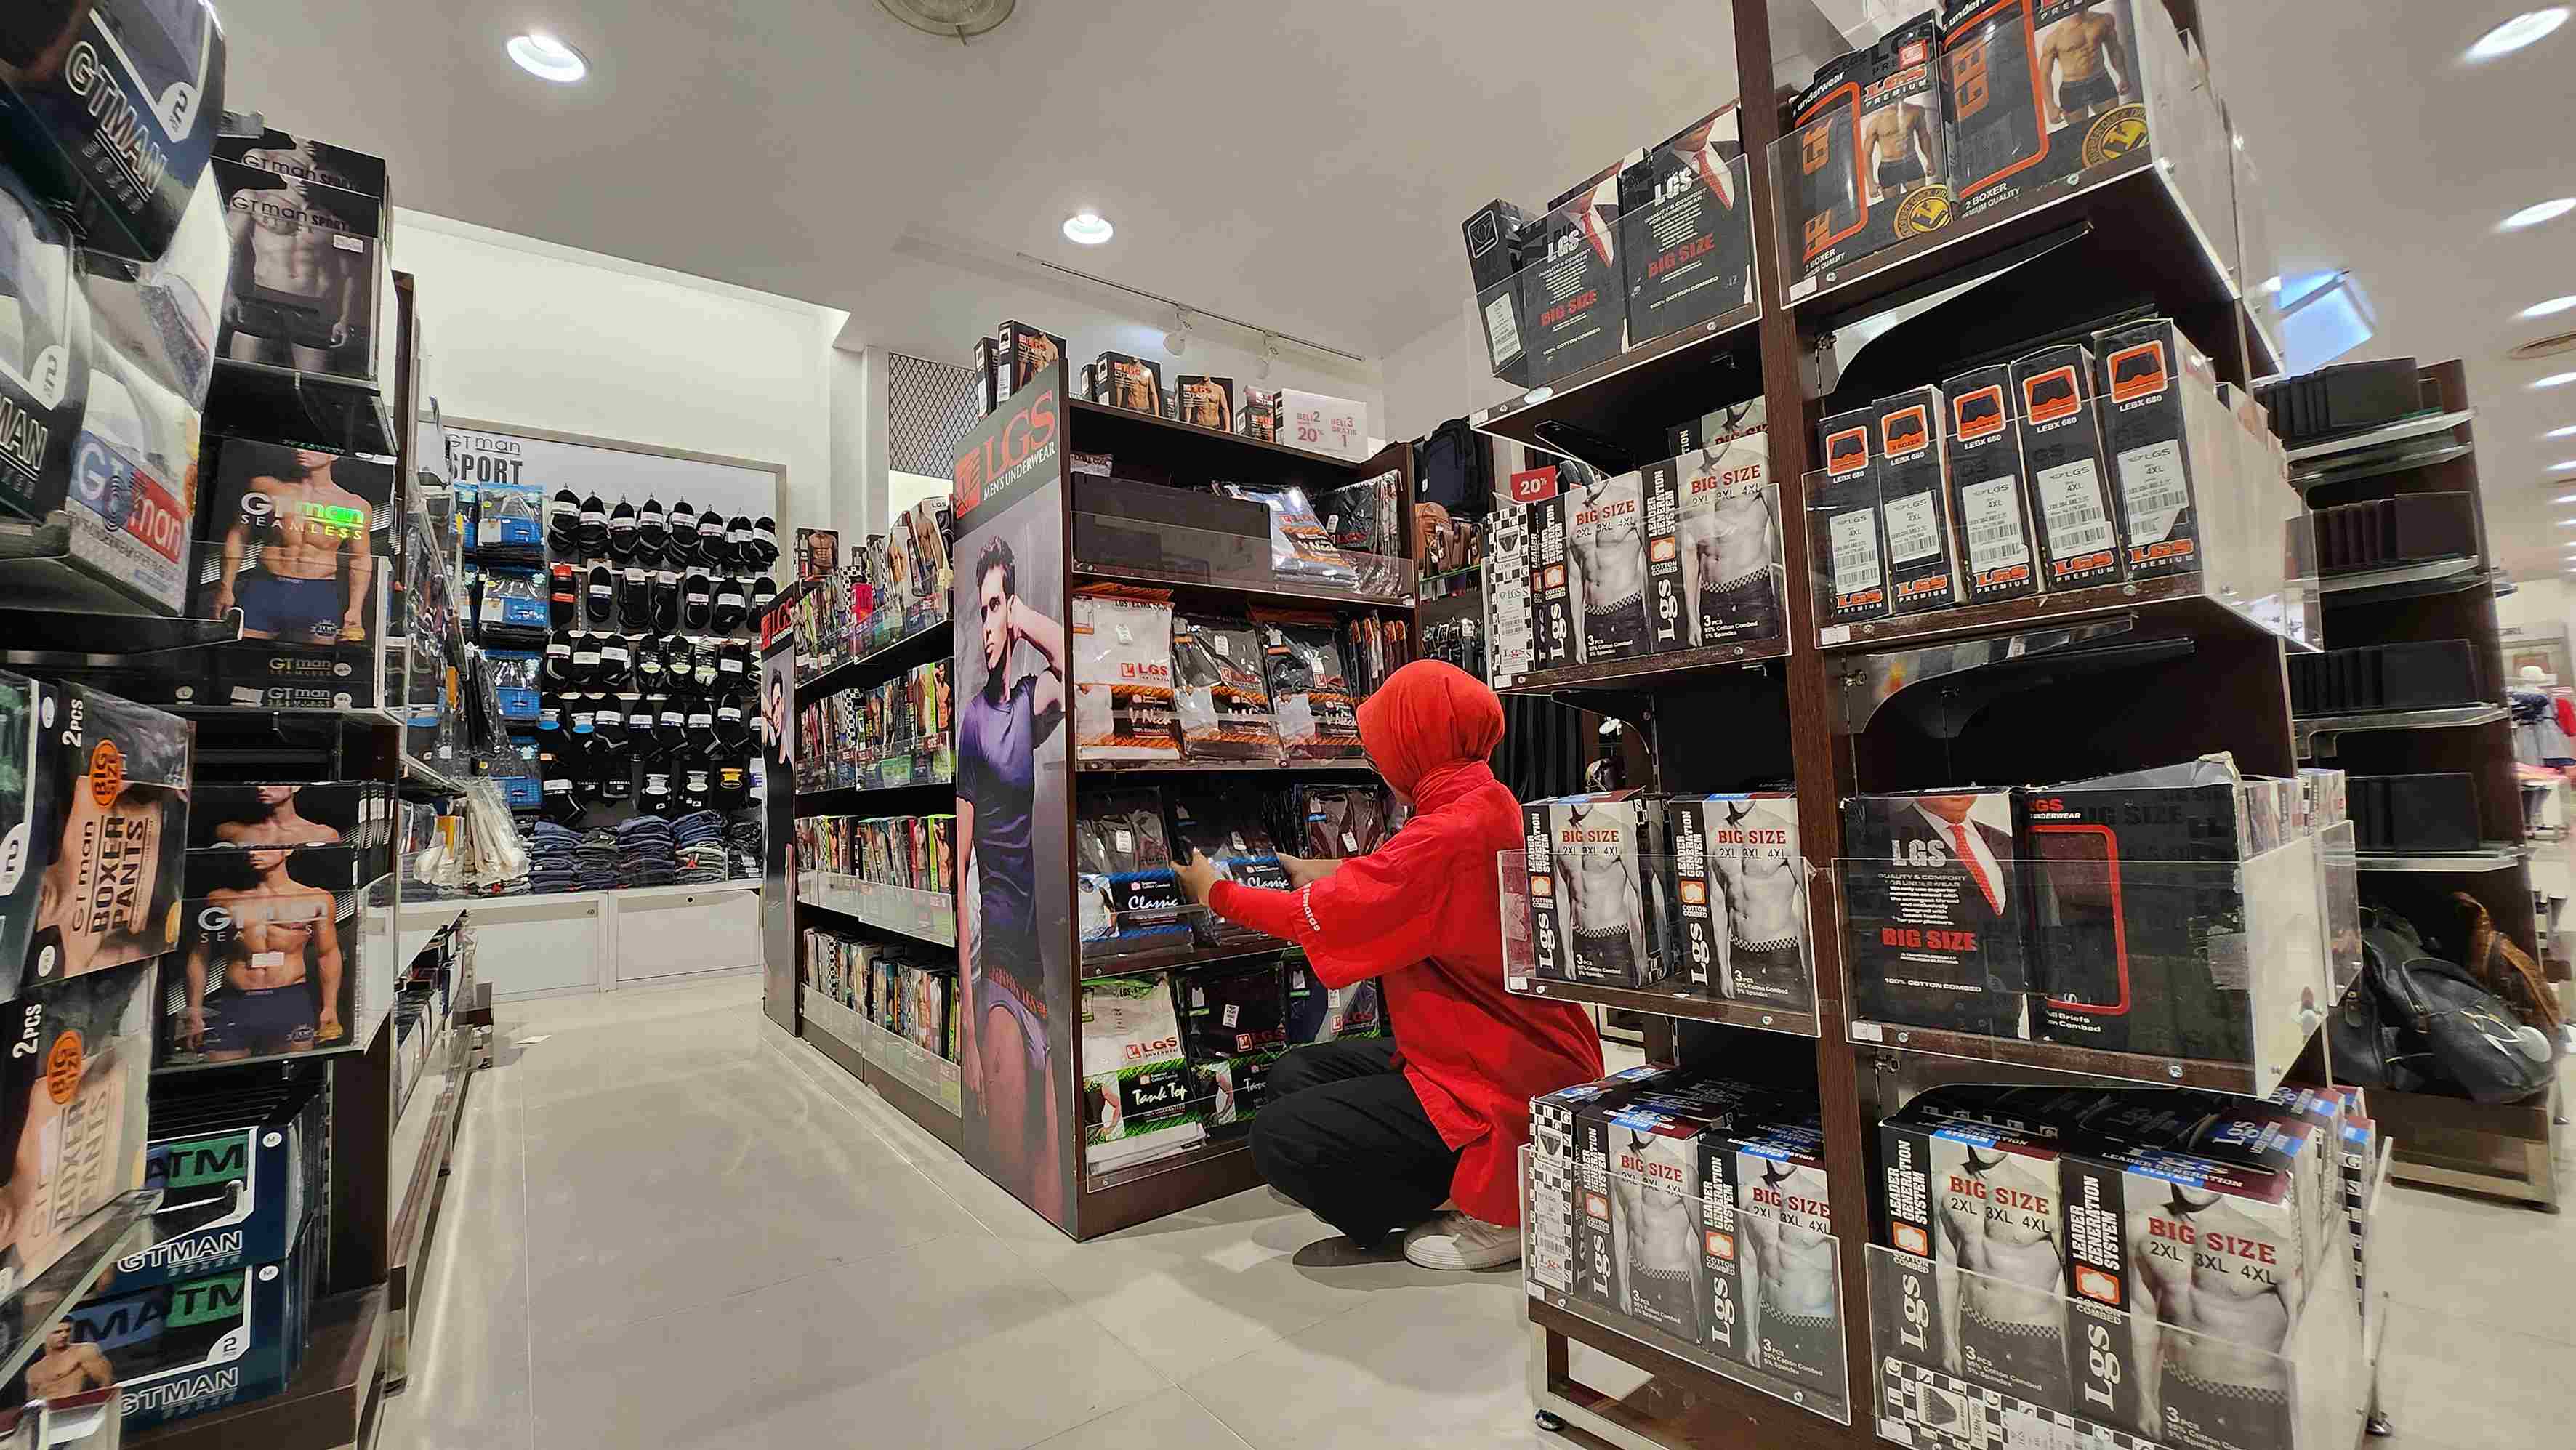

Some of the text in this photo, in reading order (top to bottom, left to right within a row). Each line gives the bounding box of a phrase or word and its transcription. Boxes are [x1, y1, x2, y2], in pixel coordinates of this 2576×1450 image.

[1797, 71, 1844, 110] underwear
[1866, 78, 1926, 108] PREMIUM
[65, 41, 168, 194] GTMAN
[174, 89, 188, 125] 2
[1654, 167, 1692, 206] LGS
[1965, 182, 2008, 210] 2 BOXER
[1988, 187, 2021, 206] QUALITY
[1548, 230, 1579, 263] LGS
[1648, 233, 1715, 279] BIG SIZE
[1810, 249, 1835, 268] BOXER
[1821, 252, 1845, 269] QUALITY
[1666, 276, 1718, 302] COTTON COMBED
[1541, 290, 1597, 326] BIG SIZE
[1557, 337, 1577, 349] COTTON
[45, 353, 58, 380] 2
[2120, 395, 2162, 412] LEBX 680
[1313, 411, 1320, 422] 2
[1347, 417, 1353, 427] 3
[2037, 416, 2077, 433] LEBX 680
[983, 389, 1055, 482] LGS
[1342, 435, 1347, 447] 1
[1964, 439, 1986, 450] LEBX
[1005, 441, 1056, 486] UNDERWEAR
[2144, 448, 2170, 459] LGS
[1691, 464, 1760, 494] BIG SIZE
[1832, 474, 1851, 483] LEBX
[2064, 466, 2090, 478] LGS
[2146, 465, 2165, 475] 4XL
[1520, 477, 1547, 496] 20%
[1741, 483, 1761, 495] 4XL
[1987, 484, 2010, 495] LGS
[2066, 482, 2084, 491] 4XL
[1575, 499, 1635, 526] BIG SIZE
[1654, 470, 1666, 536] GENERATION
[1665, 490, 1675, 533] SYSTEM
[1616, 517, 1635, 528] 4XL
[1647, 496, 1656, 537] LEADER
[2052, 551, 2114, 577] LGS
[2128, 538, 2194, 564] LGS
[2131, 555, 2194, 571] PREMIUM
[1651, 560, 1678, 571] COTTON
[2056, 566, 2114, 582] PREMIUM
[1899, 589, 1947, 603] PREMIUM
[1976, 579, 2030, 594] PREMIUM
[1838, 603, 1882, 614] PREMIUM
[1138, 662, 1168, 676] LGS
[1533, 813, 1542, 872] GENERATION
[1562, 831, 1619, 842] BIG SIZE
[1683, 810, 1695, 877] GENERATION
[1718, 830, 1787, 844] BIG SIZE
[1, 839, 19, 872] 2
[1541, 834, 1550, 872] SYSTEM
[1676, 835, 1686, 876] LEADER
[1694, 834, 1704, 877] SYSTEM
[1891, 839, 1947, 868] LGS
[91, 815, 126, 934] BOXER
[112, 818, 145, 930] PANTS
[1247, 876, 1289, 889] Classic
[1128, 895, 1179, 910] Classic
[1881, 927, 1978, 951] BIG SIZE
[1576, 954, 1582, 965] 3
[1734, 970, 1742, 981] 3
[1907, 980, 1942, 988] COTTON
[1943, 983, 1982, 992] COMBED
[2058, 1012, 2091, 1024] Briefs
[2058, 1023, 2101, 1033] Combed
[1140, 1036, 1178, 1053] LGS
[1132, 1082, 1188, 1105] Tank Top
[1582, 1149, 1592, 1191] LEADER
[1588, 1127, 1598, 1193] GENERATION
[1621, 1154, 1683, 1183] BIG SIZE
[1598, 1151, 1608, 1196] SYSTEM
[1898, 1139, 1913, 1222] GENERATION
[1704, 1180, 1714, 1228] LEADER
[1712, 1156, 1723, 1229] GENERATION
[1752, 1186, 1831, 1219] BIG SIZE
[1887, 1167, 1901, 1217] LEADER
[1912, 1170, 1928, 1225] SYSTEM
[1949, 1175, 2050, 1215] BIG SIZE
[1723, 1184, 1734, 1233] SYSTEM
[1950, 1197, 2050, 1233] 2XL 3XL 4XL
[2083, 1175, 2103, 1266] GENERATION
[2069, 1204, 2087, 1262] LEADER
[2101, 1209, 2120, 1271] SYSTEM
[2148, 1216, 2277, 1265] BIG SIZE
[117, 1230, 243, 1273] GTMAN
[1706, 1256, 1736, 1269] COTTON
[2149, 1240, 2277, 1286] 2XL 3XL 4XL
[1893, 1257, 1929, 1275] COMBED
[1633, 1289, 1640, 1302] 3
[2076, 1304, 2122, 1326] COMBED
[223, 1337, 237, 1353] 2
[1762, 1338, 1773, 1352] 3
[1965, 1345, 1976, 1361] 3
[121, 1366, 238, 1417] GTMAN
[2166, 1406, 2180, 1423] 3
